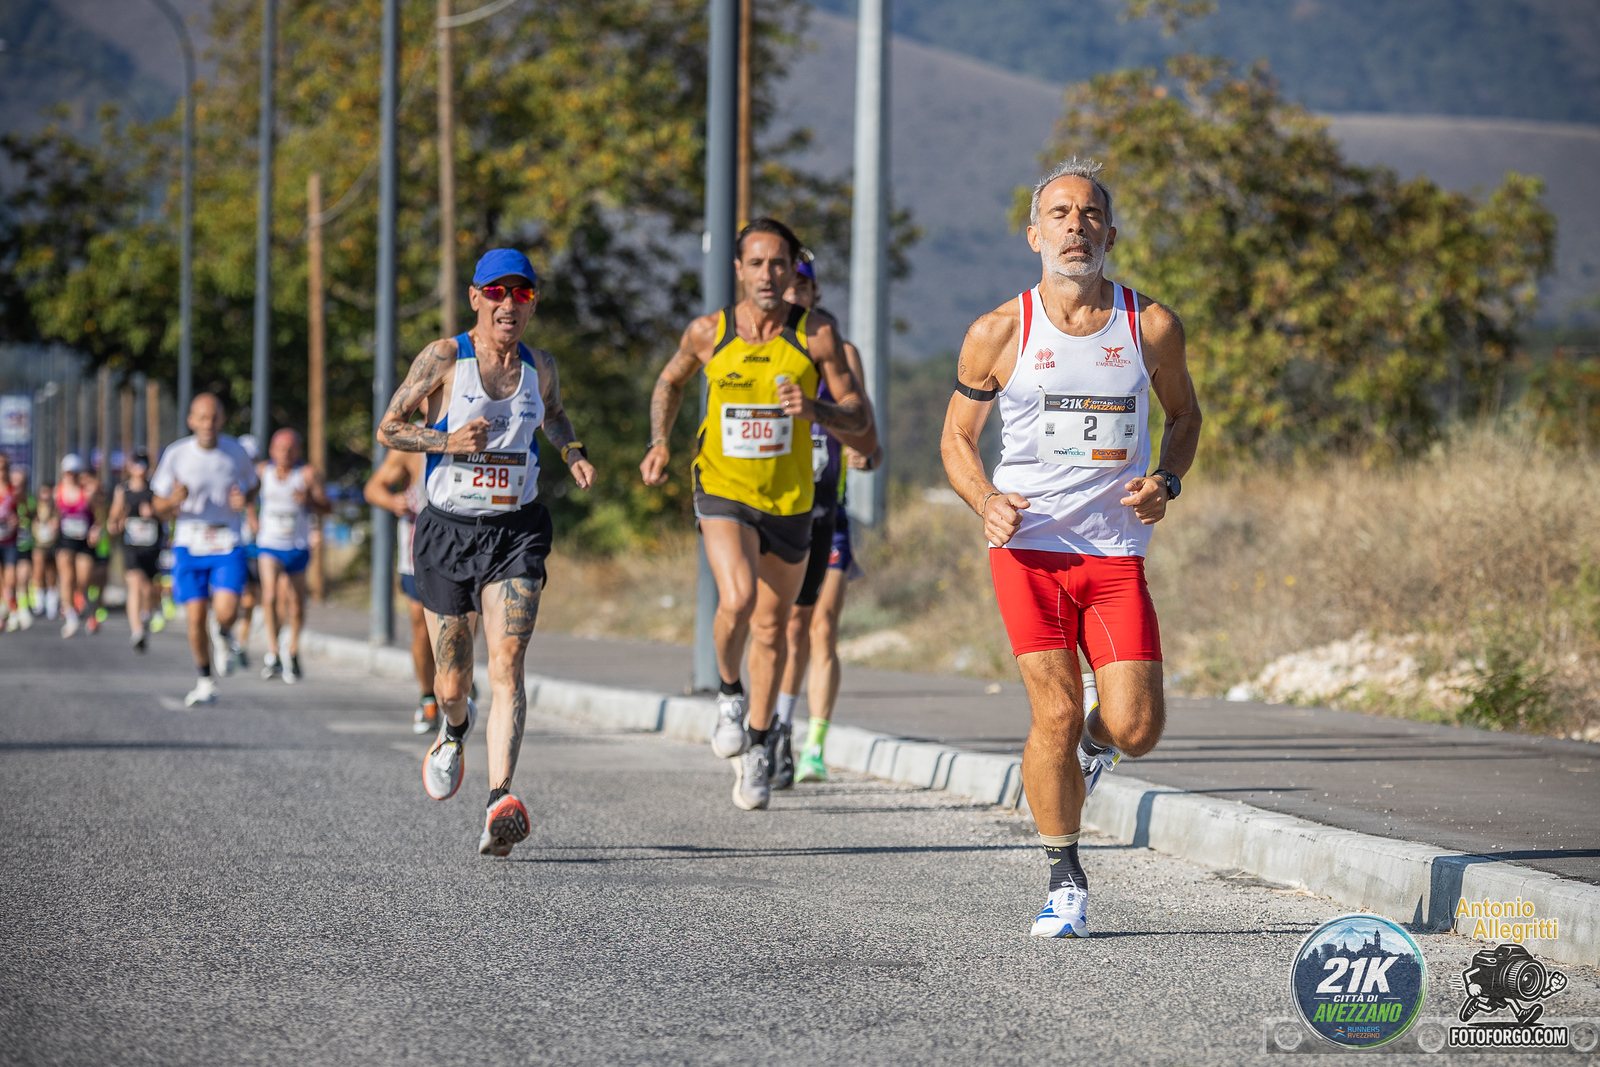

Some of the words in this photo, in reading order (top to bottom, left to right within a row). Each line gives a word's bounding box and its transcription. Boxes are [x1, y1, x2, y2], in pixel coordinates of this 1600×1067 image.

[1060, 398, 1084, 410] 21K
[741, 421, 773, 439] 206
[1084, 416, 1098, 441] 2
[466, 453, 487, 464] 10K
[473, 467, 509, 488] 238
